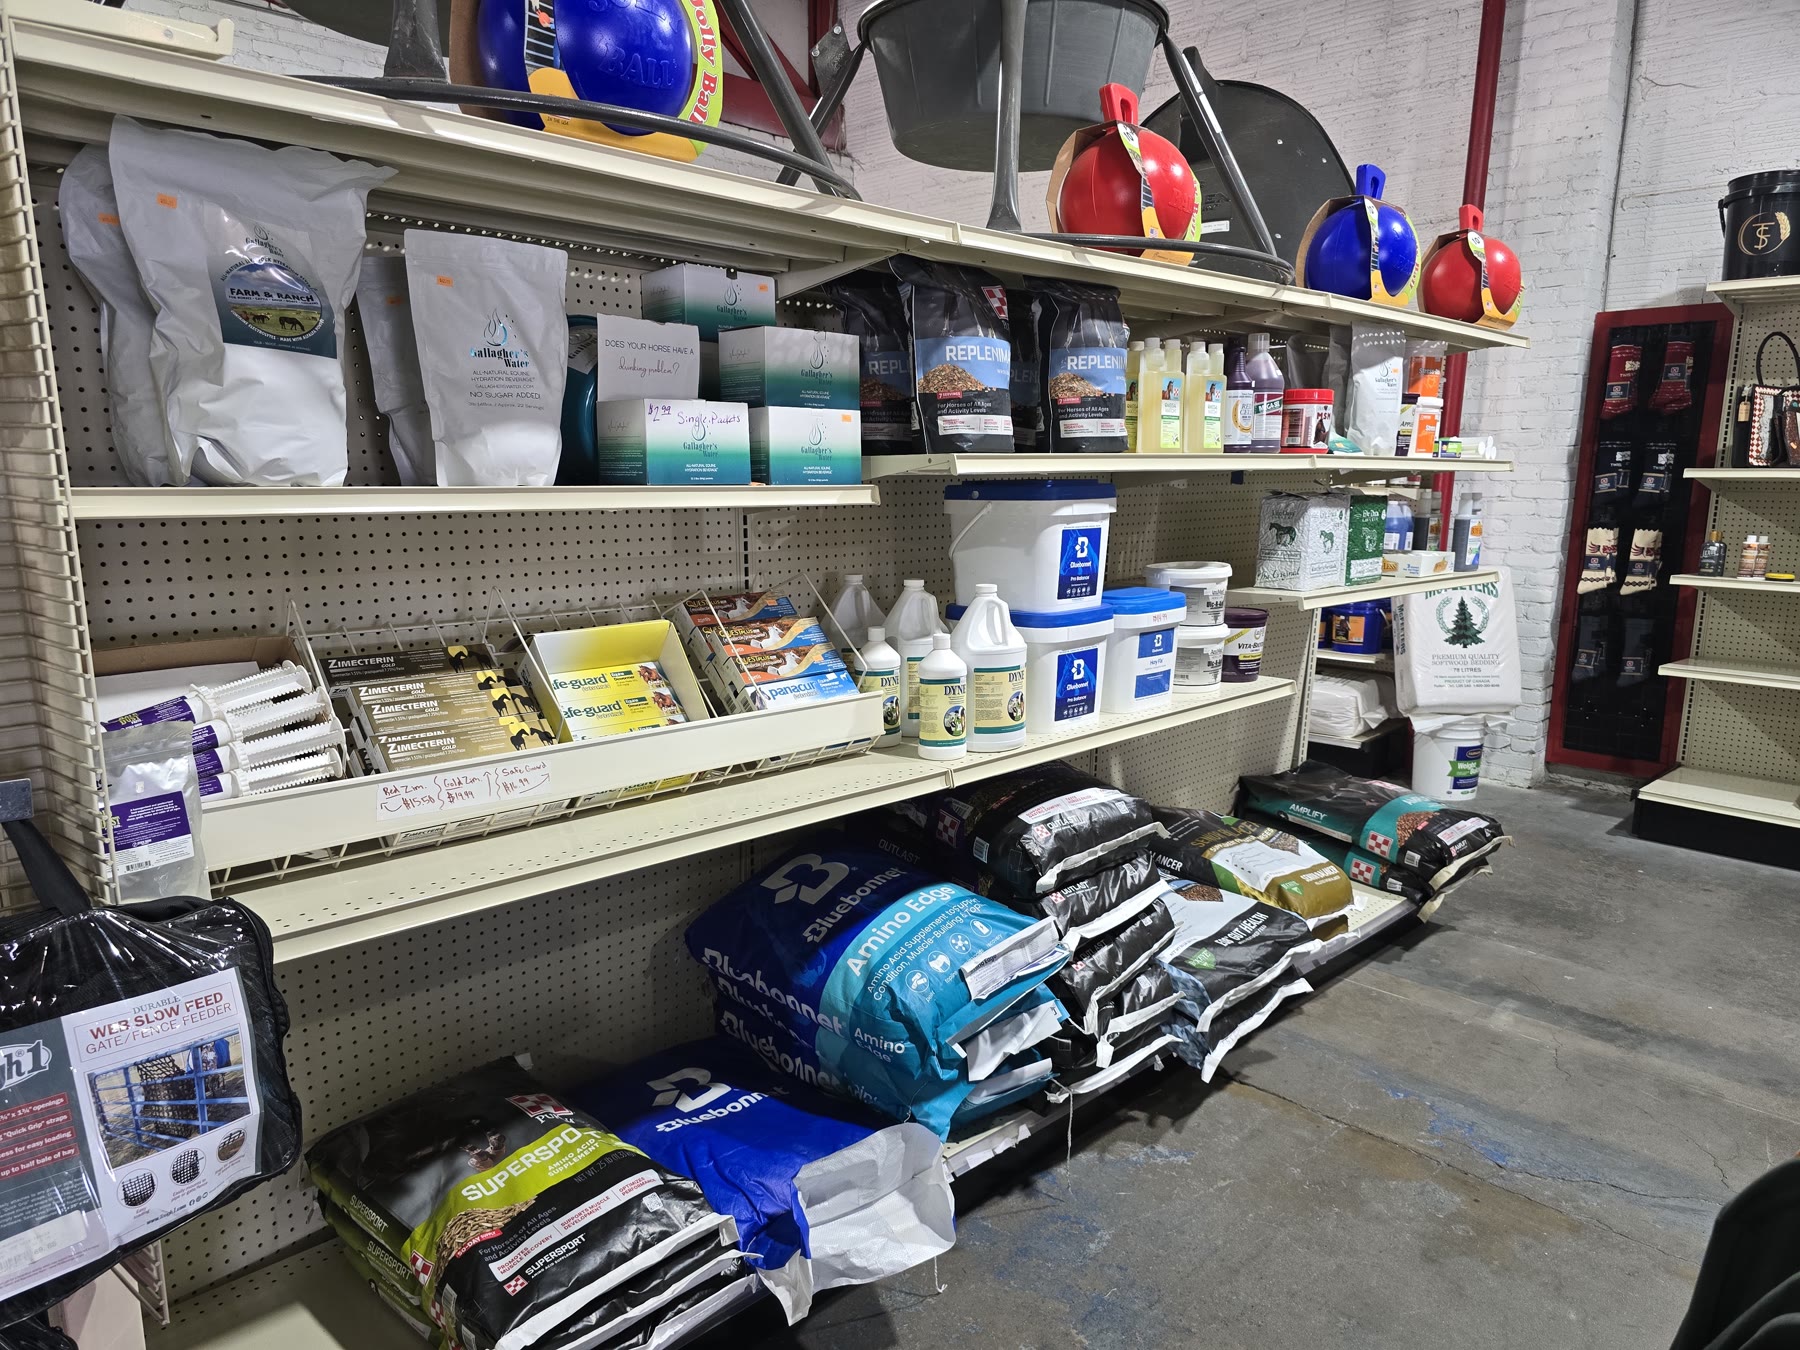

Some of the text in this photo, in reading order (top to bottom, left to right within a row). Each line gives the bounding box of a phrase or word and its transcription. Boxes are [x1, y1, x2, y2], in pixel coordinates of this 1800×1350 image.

[229, 287, 315, 302] FARM & RANCH
[469, 347, 529, 360] Gallagher's
[605, 339, 625, 349] DOES
[627, 341, 647, 351] YOUR
[648, 342, 671, 353] HORSE
[672, 346, 688, 355] HAVE
[504, 358, 530, 368] Water
[484, 391, 514, 399] SUGAR
[677, 411, 709, 428] Single
[683, 441, 718, 451] Gallagher's
[327, 655, 395, 669] ZIMECTERIN
[1008, 670, 1025, 683] DYNE
[1066, 681, 1089, 691] Bluebonnet
[358, 682, 425, 697] ZIMECTERIN
[768, 681, 817, 700] panacur
[371, 700, 438, 715] ZIMECTERIN
[386, 736, 456, 754] ZIMECTERIN
[501, 761, 547, 777] Safe Guard
[382, 784, 401, 796] Red
[443, 776, 463, 788] Gold
[1289, 803, 1327, 821] AMPLIFY
[878, 838, 921, 865] OUTLAST
[802, 866, 908, 944] Bluebonnet
[846, 885, 956, 977] Amino Edge
[1227, 911, 1270, 942] GUT HEALTH
[867, 907, 955, 993] Amino Acid Supplement to
[873, 915, 964, 1001] Condition, Muscle-Building
[89, 991, 223, 1040] WEB SLOW FEED
[132, 995, 181, 1015] DURABLE
[85, 1002, 232, 1055] GATE/FENCE FEEDER
[854, 1027, 906, 1054] Amino
[32, 1097, 65, 1111] openings
[3, 1114, 68, 1138] "Quick Grip" straps
[14, 1130, 72, 1154] for easy loading
[548, 1138, 596, 1170] AMINO ACID
[0, 1147, 76, 1177] up to half bale of hay
[460, 1126, 602, 1202] SUPERSPOT
[547, 1142, 600, 1177] SUPPLEMENT
[574, 1171, 587, 1184] NET
[618, 1176, 645, 1192] OPTIMIZES
[350, 1194, 389, 1233] SUPERSPORT
[560, 1195, 611, 1228] SUPPORTS MUSCLE
[563, 1206, 602, 1231] DEVELOPMENT
[478, 1207, 558, 1256] For Horses of All Ages
[483, 1217, 551, 1263] and Activity Levels
[367, 1240, 412, 1281] SUPERSPORT
[496, 1246, 529, 1272] PROMOTES
[500, 1234, 554, 1275] MUSCLE RECOVERY
[524, 1233, 586, 1276] SUPERSPORT
